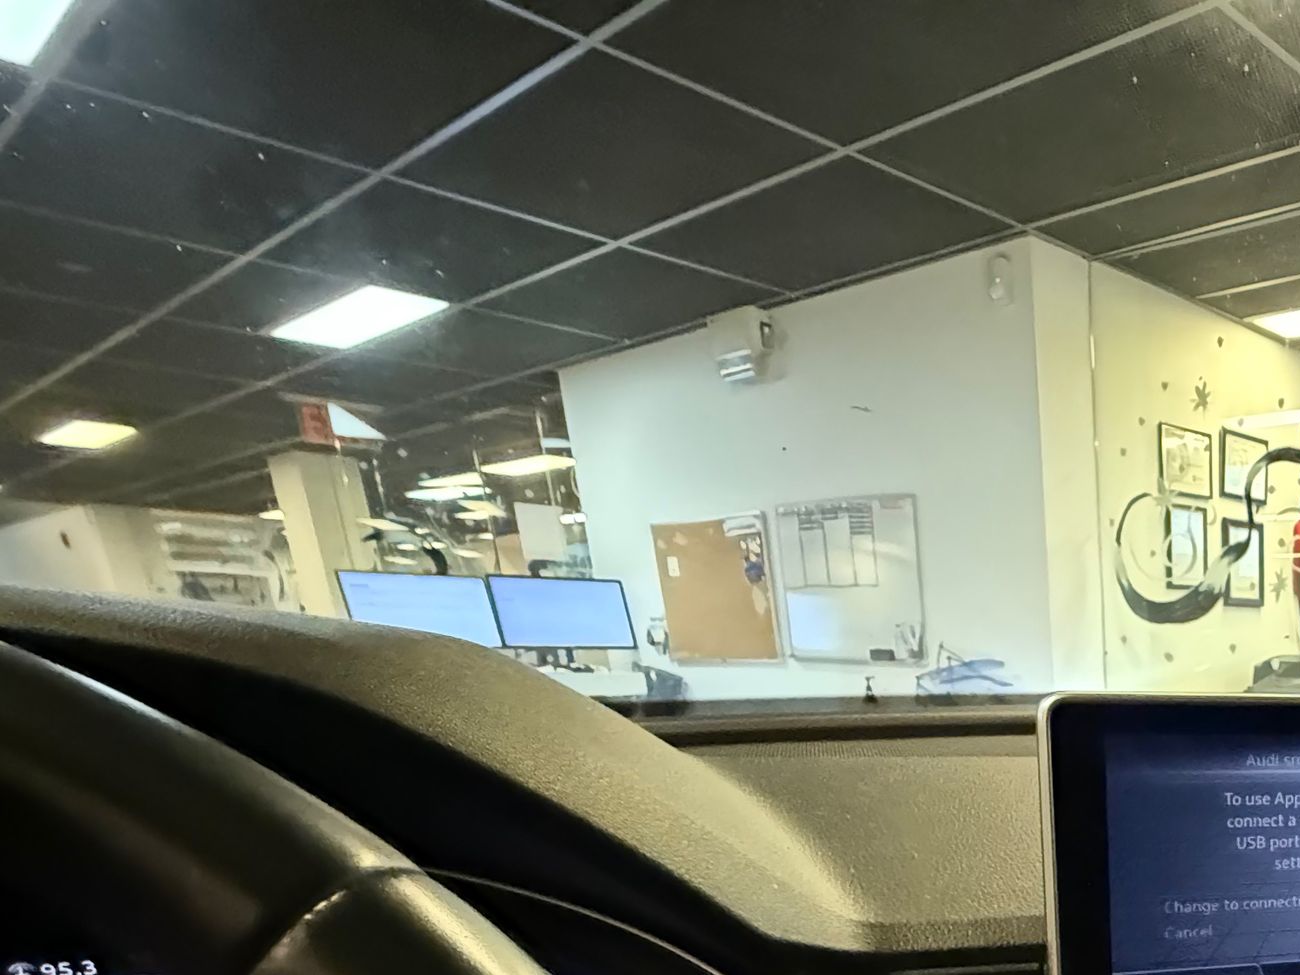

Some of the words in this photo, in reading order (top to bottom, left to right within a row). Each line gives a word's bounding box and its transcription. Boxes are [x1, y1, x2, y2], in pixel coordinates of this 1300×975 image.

[1246, 753, 1279, 767] Audi
[1224, 792, 1242, 806] To
[1245, 794, 1271, 806] use
[1227, 814, 1284, 828] connect
[1288, 816, 1297, 827] a
[1236, 835, 1266, 850] USB
[1164, 899, 1218, 916] Change
[1224, 899, 1239, 912] to
[1164, 924, 1213, 940] Cancel
